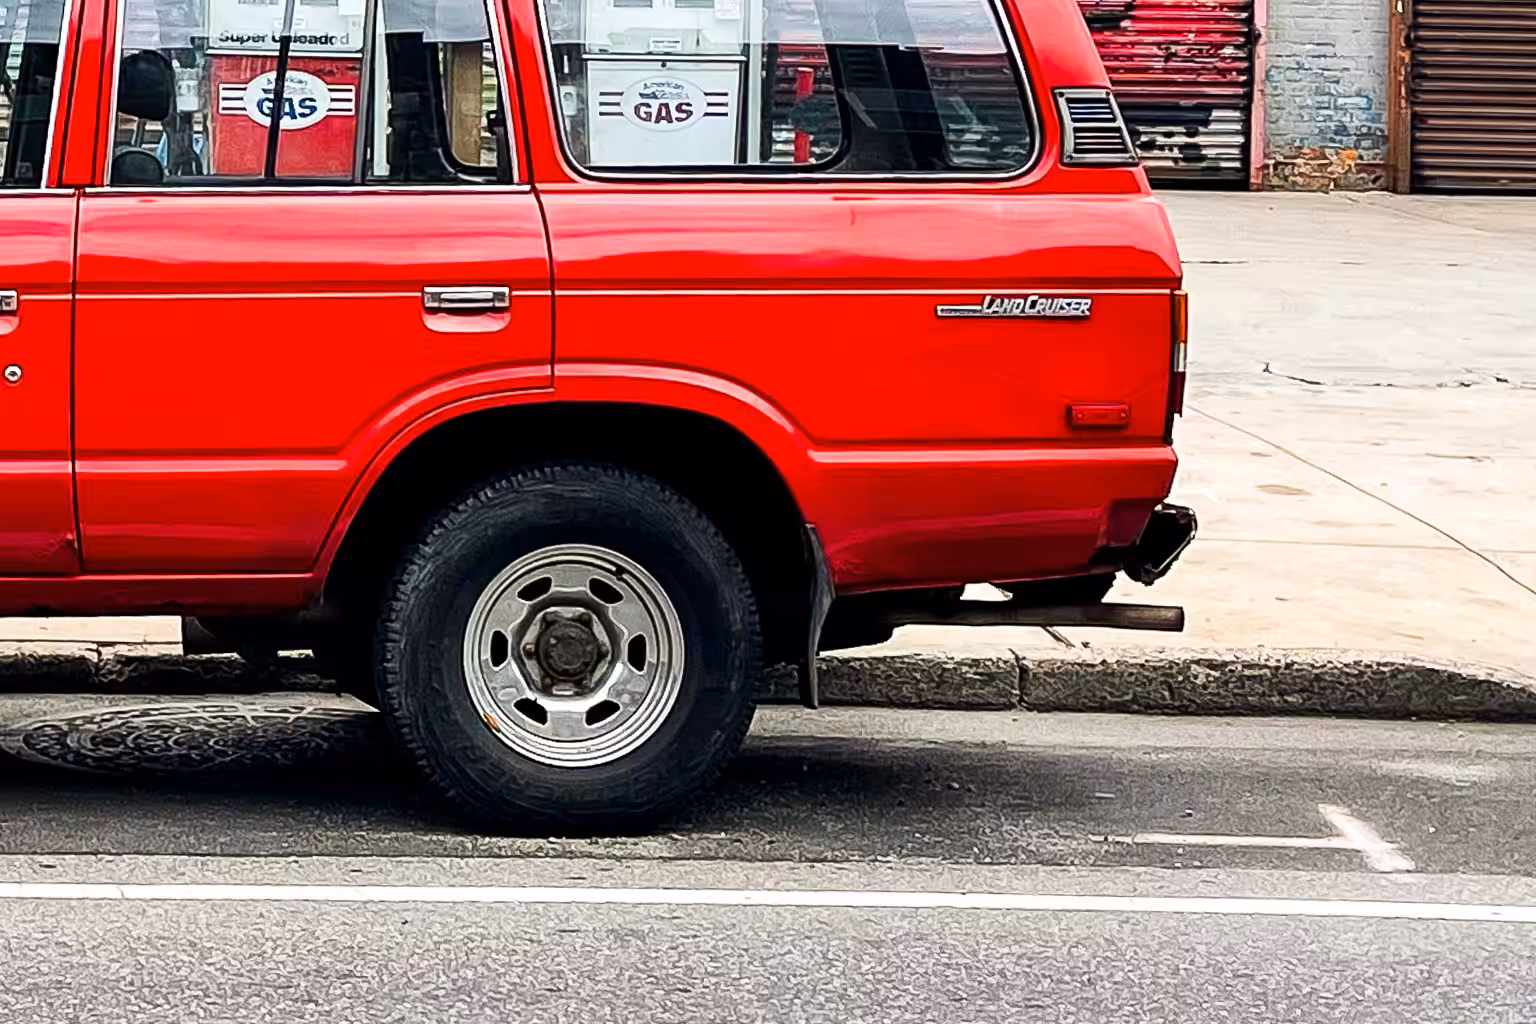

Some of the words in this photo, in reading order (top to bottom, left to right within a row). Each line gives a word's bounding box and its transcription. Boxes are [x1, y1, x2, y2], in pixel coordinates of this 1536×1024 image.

[218, 30, 269, 45] Super
[256, 96, 318, 120] GAS
[633, 102, 694, 124] GAS
